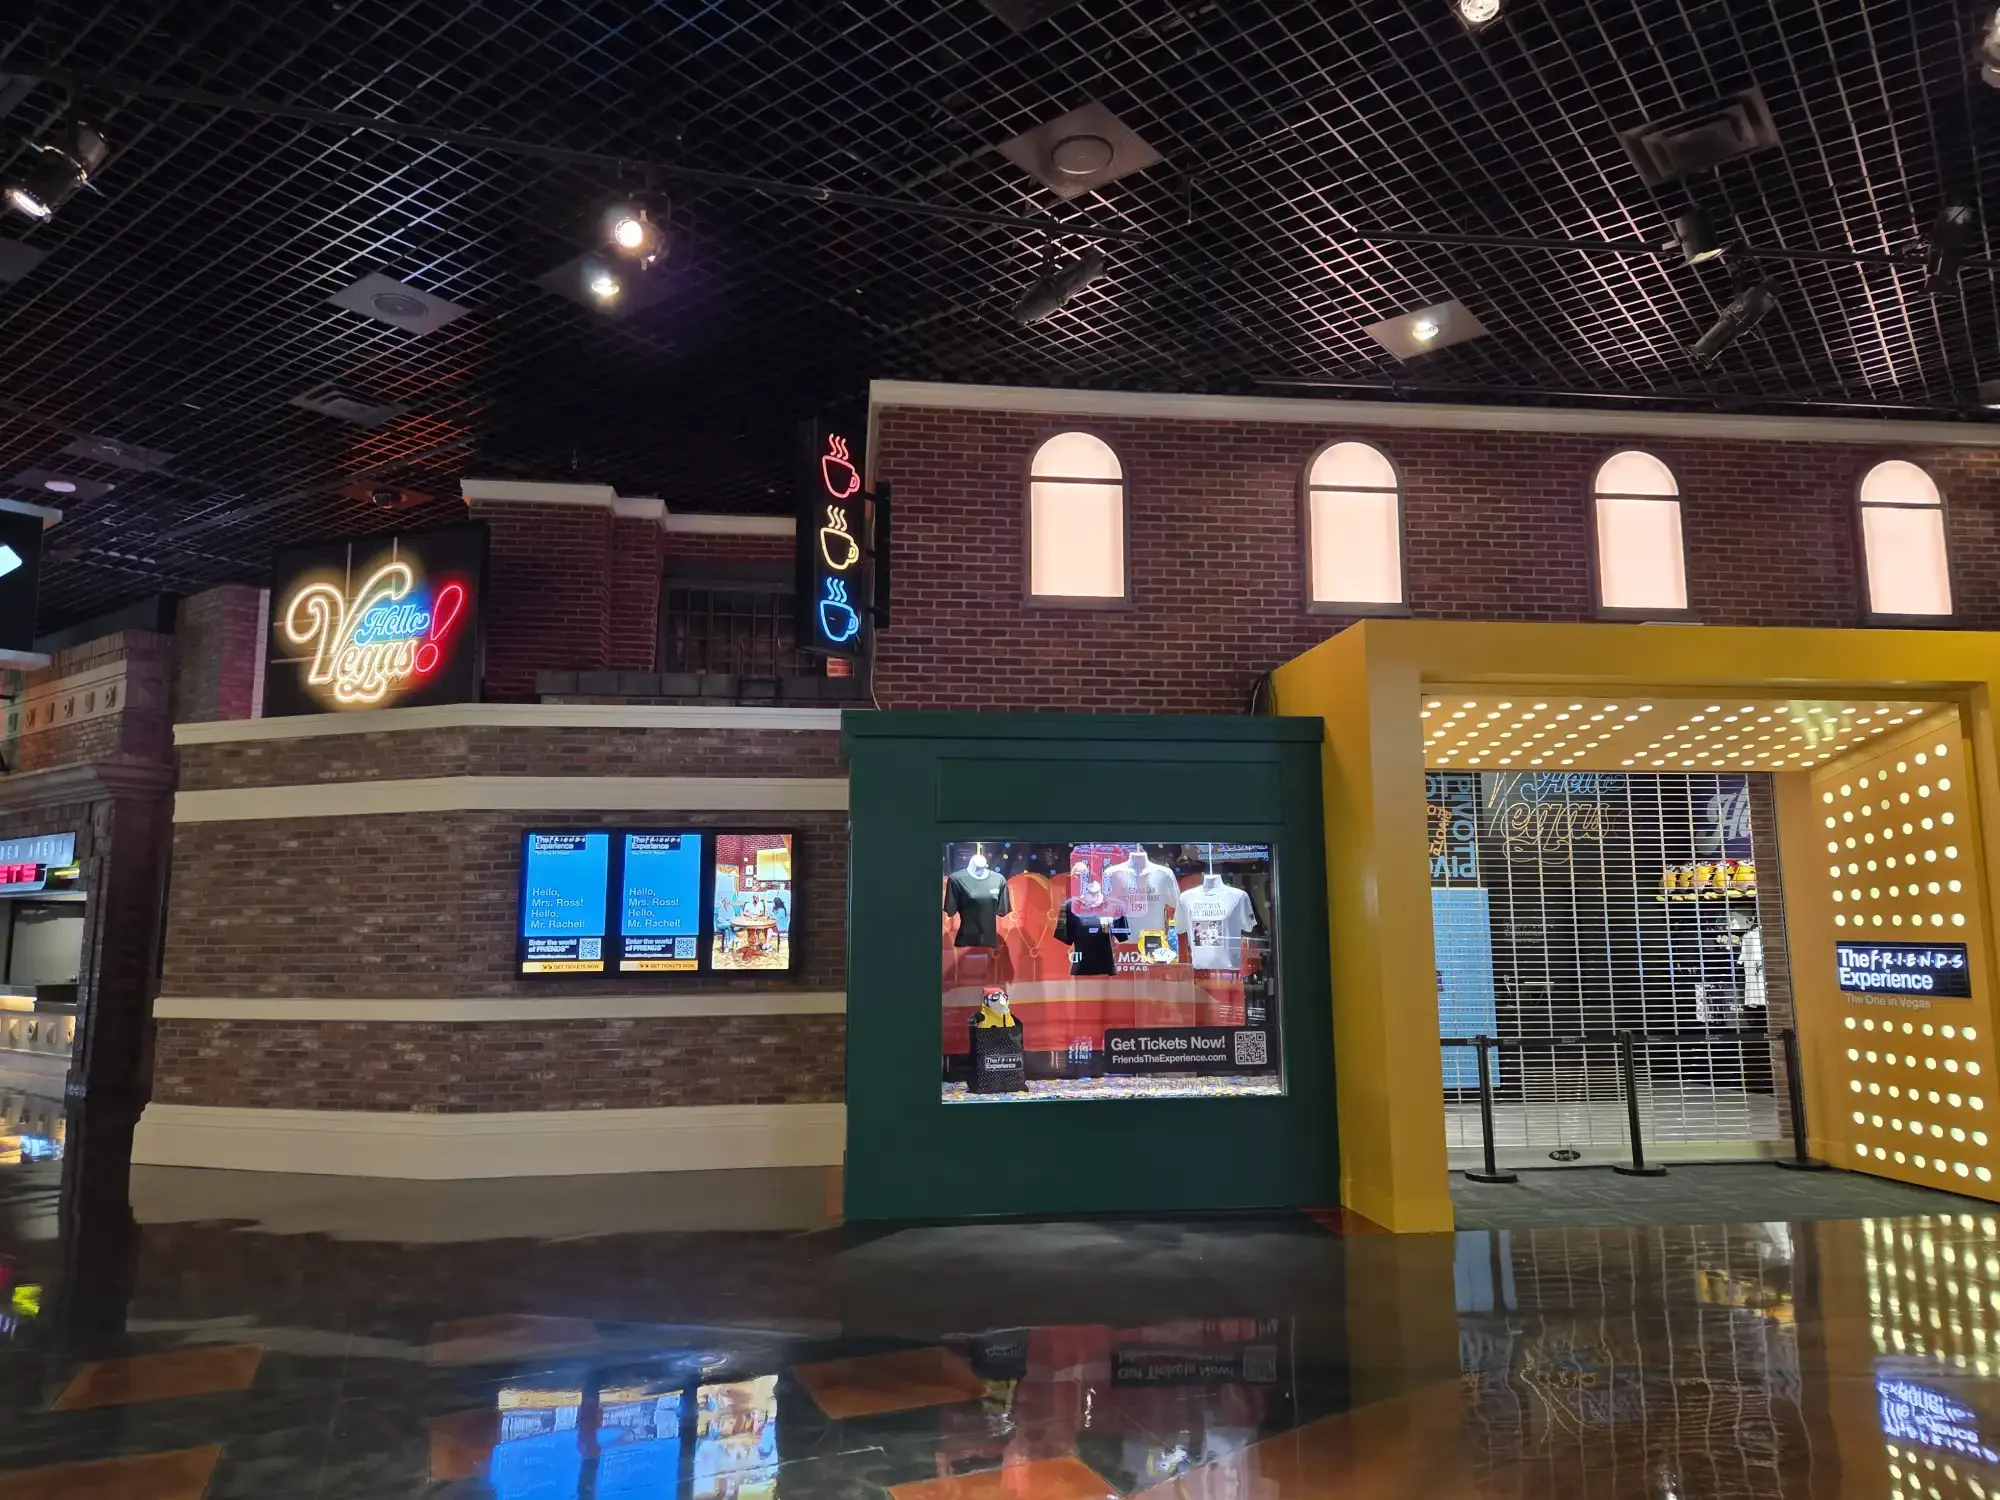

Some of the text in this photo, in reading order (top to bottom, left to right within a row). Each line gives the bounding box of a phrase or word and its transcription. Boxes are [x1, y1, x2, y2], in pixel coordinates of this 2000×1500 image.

[353, 603, 430, 646] Hello
[532, 888, 560, 897] Hello,
[629, 887, 656, 897] Hello,
[532, 898, 584, 907] Mrs. Ross!
[628, 898, 679, 906] Mrs. Ross!
[531, 909, 559, 918] Hello,
[628, 909, 655, 917] Hello,
[531, 920, 585, 928] Mr. Rachel!
[627, 919, 681, 928] Mr. Rachel!
[1837, 949, 1870, 968] The
[1839, 967, 1934, 990] Experience
[1845, 993, 1932, 1010] The One in Vegas
[1111, 1035, 1226, 1051] Get Tickets Now!
[1112, 1053, 1227, 1064] FriendsTheExperience.com
[1170, 1079, 1195, 1092] Daily
